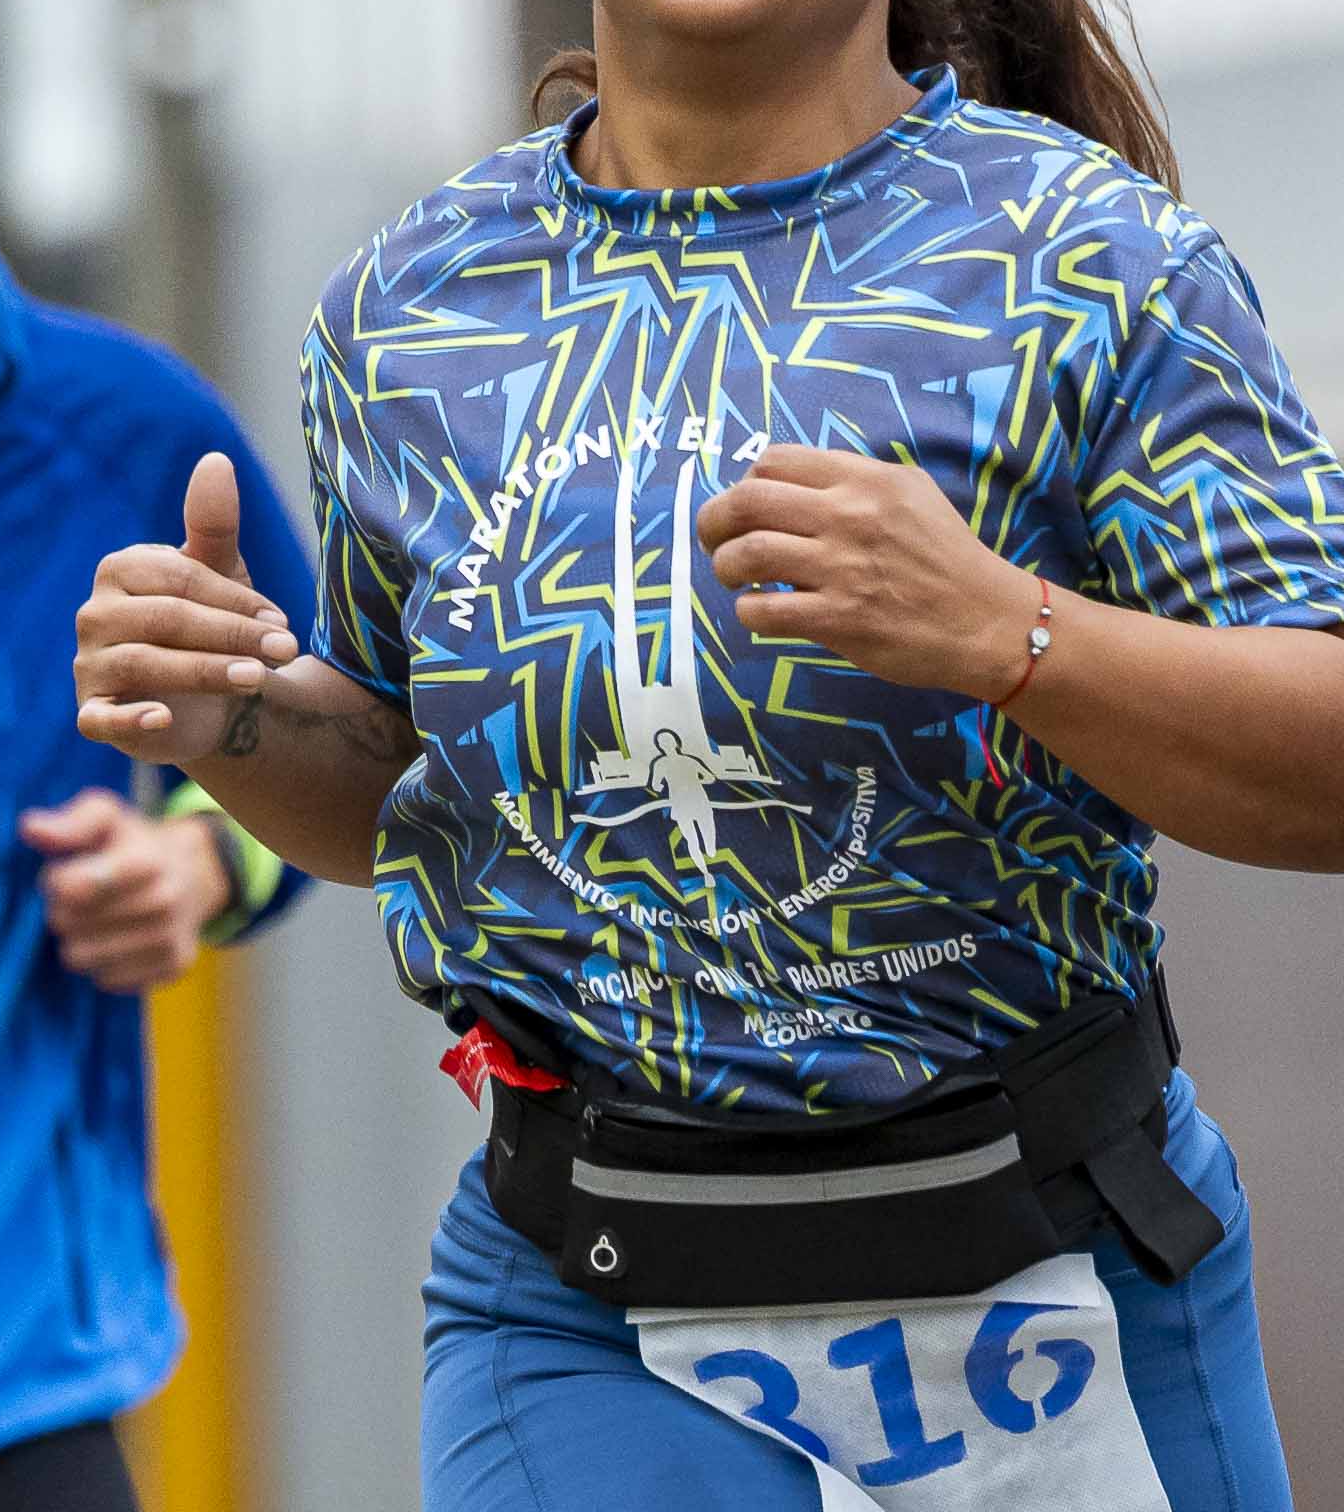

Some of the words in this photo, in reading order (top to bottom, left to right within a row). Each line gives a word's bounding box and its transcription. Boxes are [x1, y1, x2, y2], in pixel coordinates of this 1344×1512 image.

[448, 425, 612, 632] MARATÓN
[628, 416, 664, 452] X
[630, 904, 761, 936] INCLUSIÓN
[848, 766, 879, 856] POSITIVA
[786, 960, 880, 995] PADRES
[881, 934, 978, 983] UNIDOS
[693, 1301, 1096, 1487] 316
